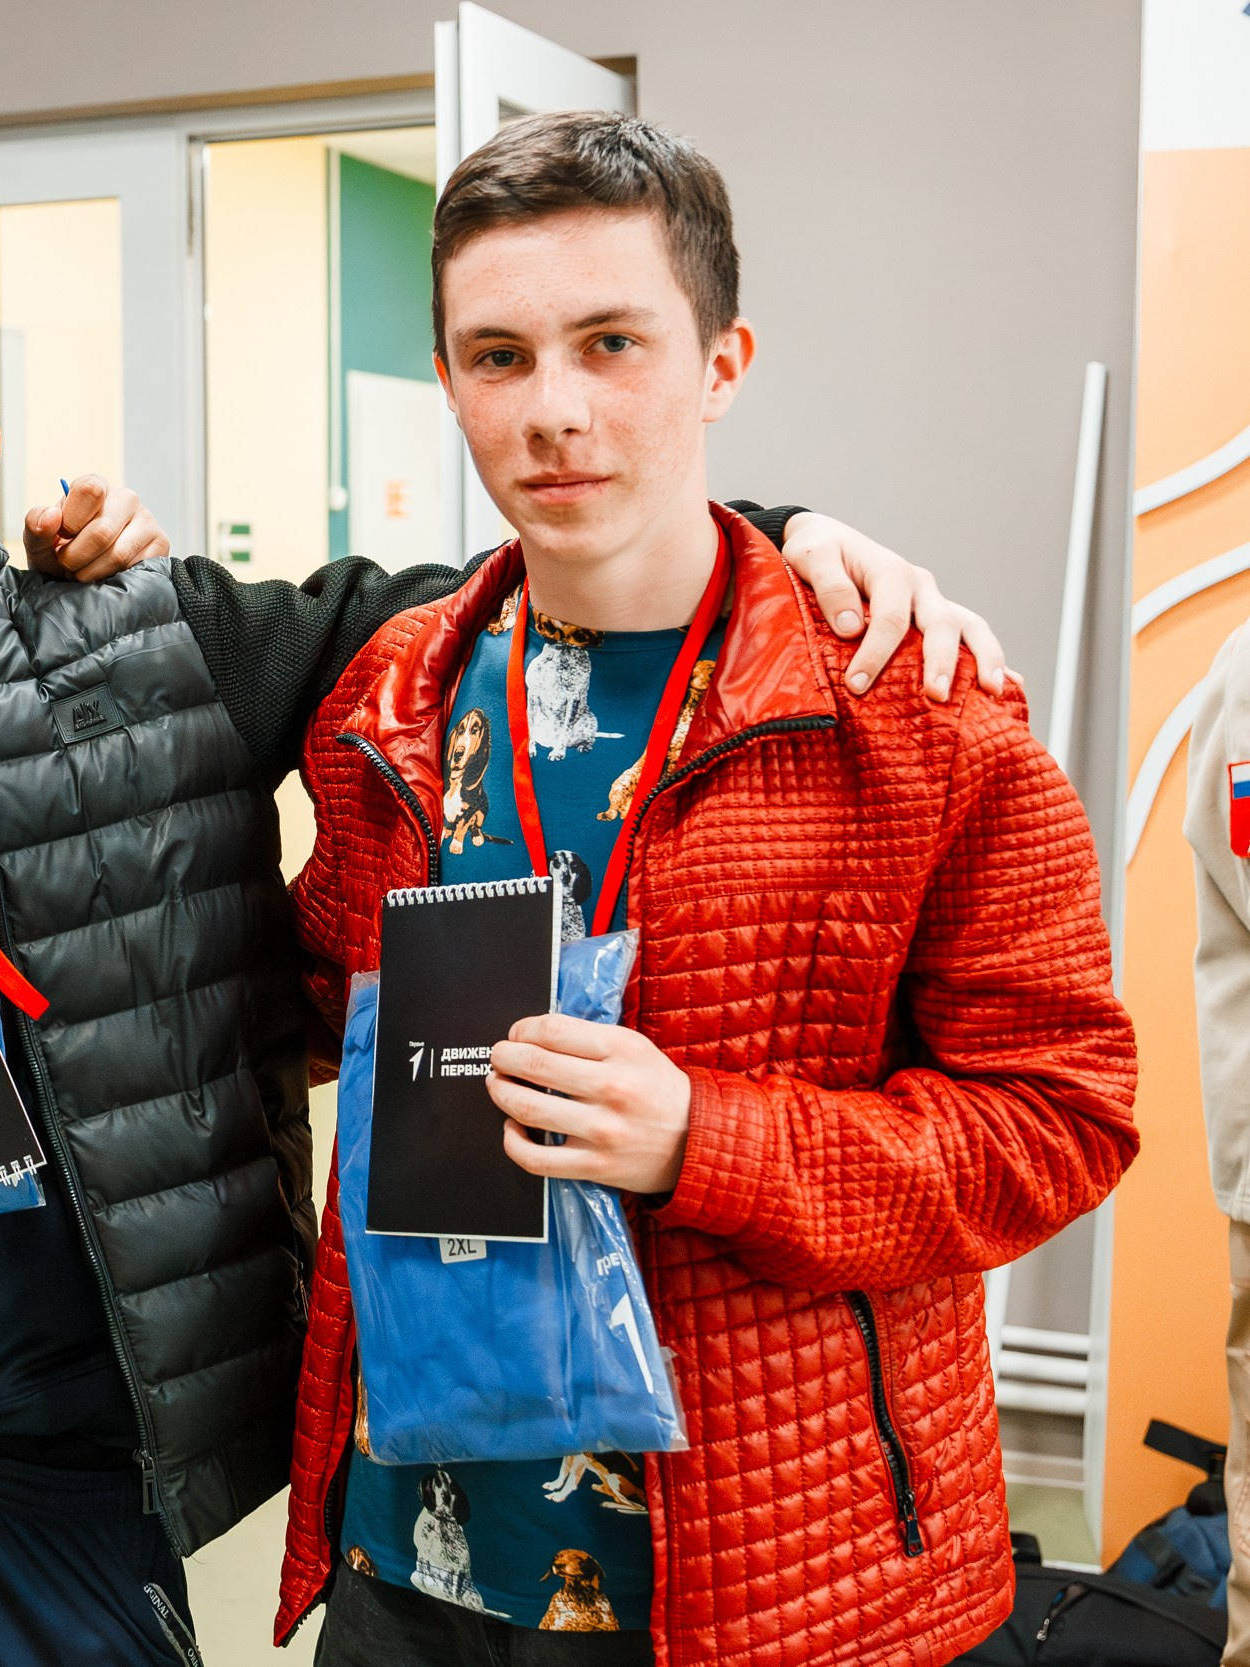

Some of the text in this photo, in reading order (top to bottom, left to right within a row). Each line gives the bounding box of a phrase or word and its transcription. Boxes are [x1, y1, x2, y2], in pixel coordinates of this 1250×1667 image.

[440, 1046, 494, 1062] ДВИЖЕН
[440, 1063, 494, 1077] ПЕРВЫХ
[447, 1237, 477, 1257] 2XL
